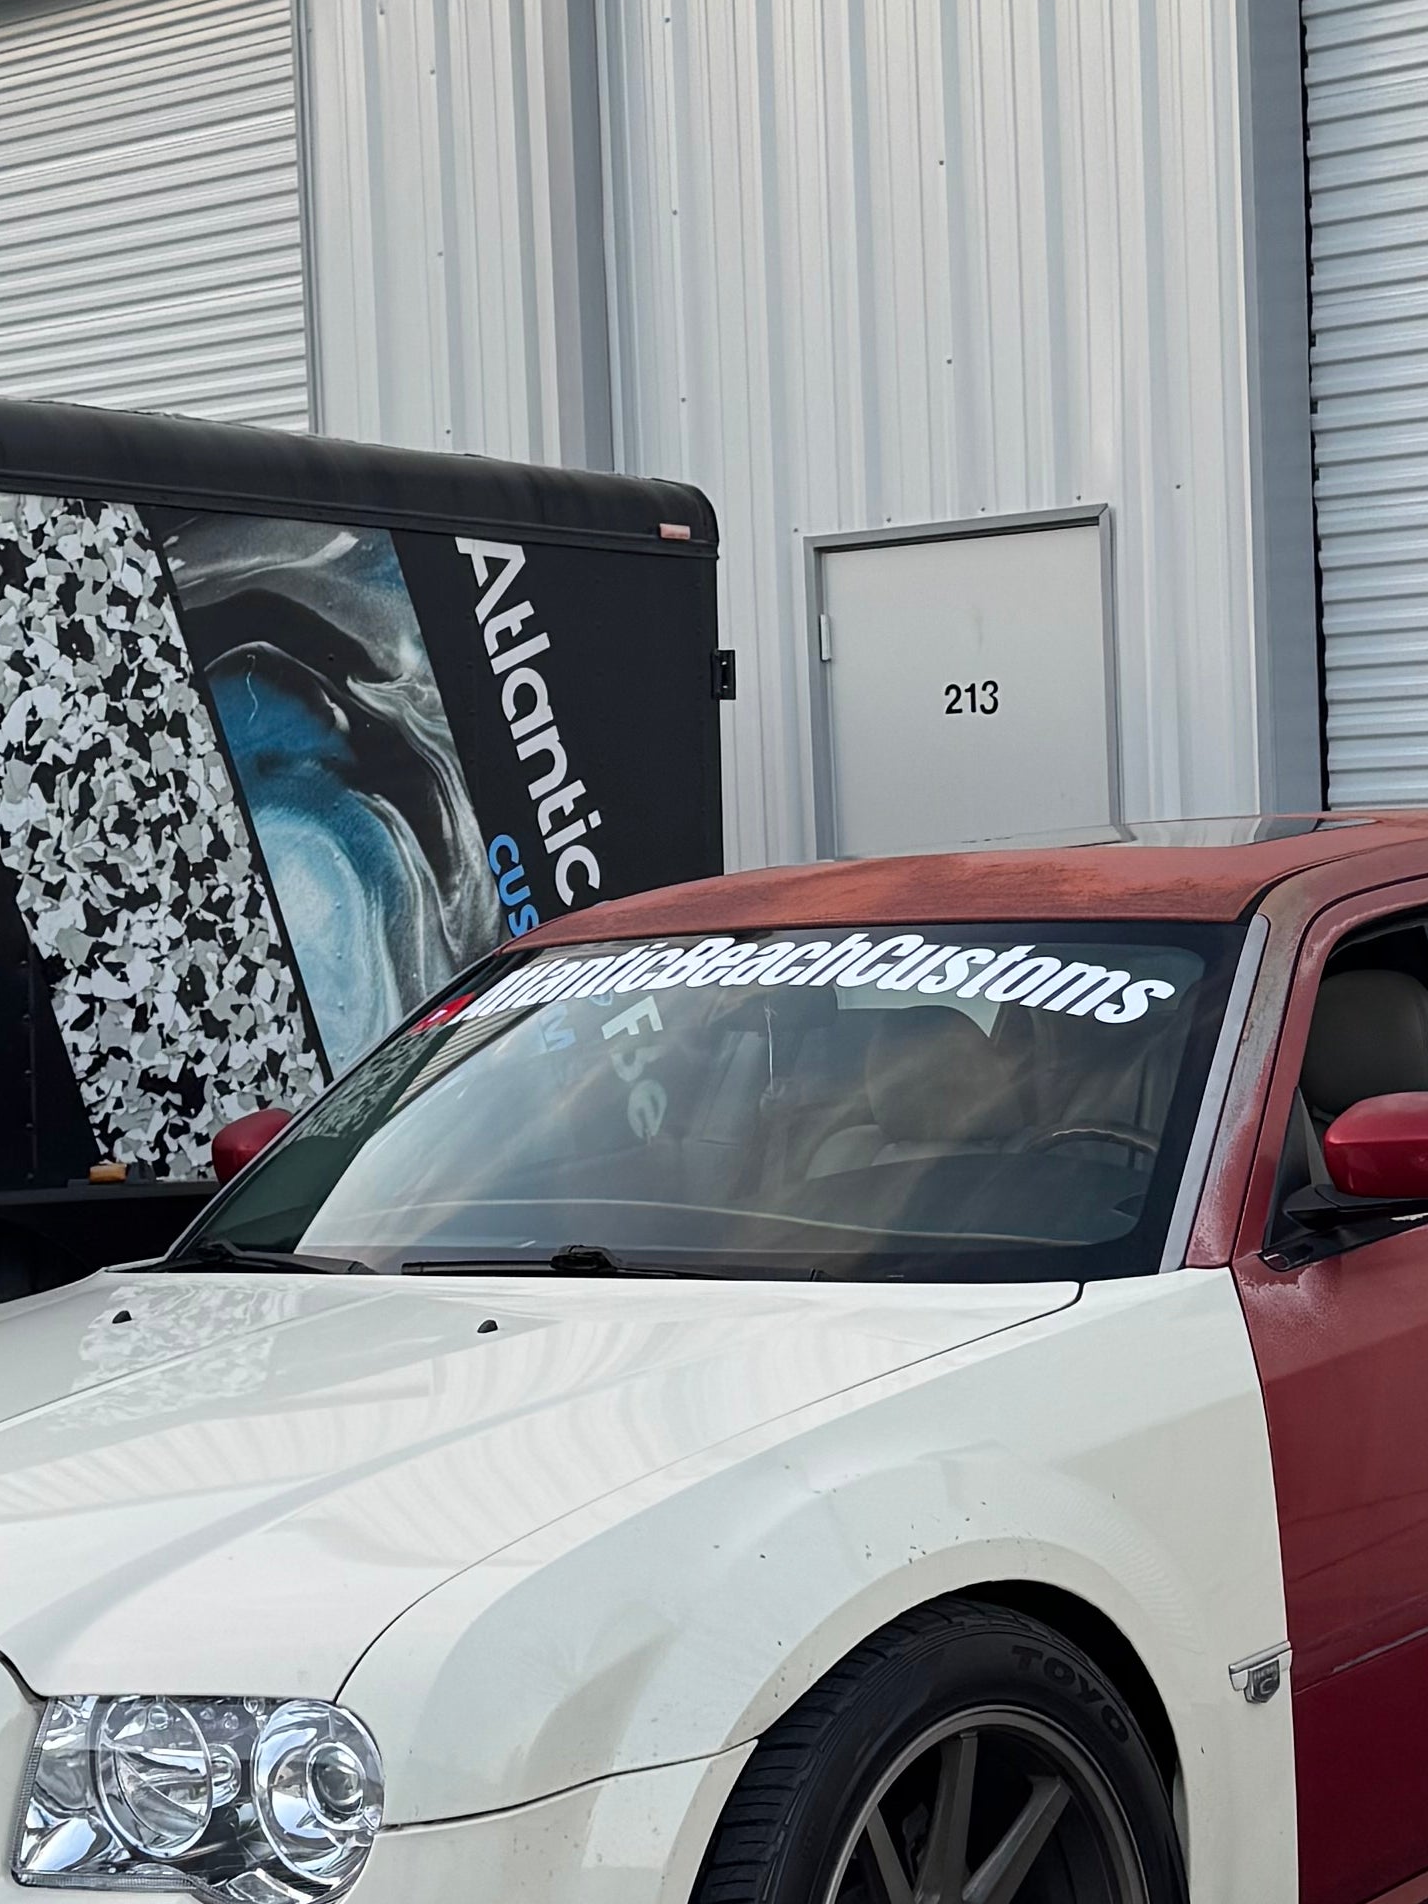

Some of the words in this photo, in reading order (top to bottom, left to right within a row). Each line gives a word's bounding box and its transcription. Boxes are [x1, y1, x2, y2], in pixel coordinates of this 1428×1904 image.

[455, 536, 601, 907] Atlantic
[945, 680, 999, 715] 213
[1012, 1645, 1130, 1744] TOYO
